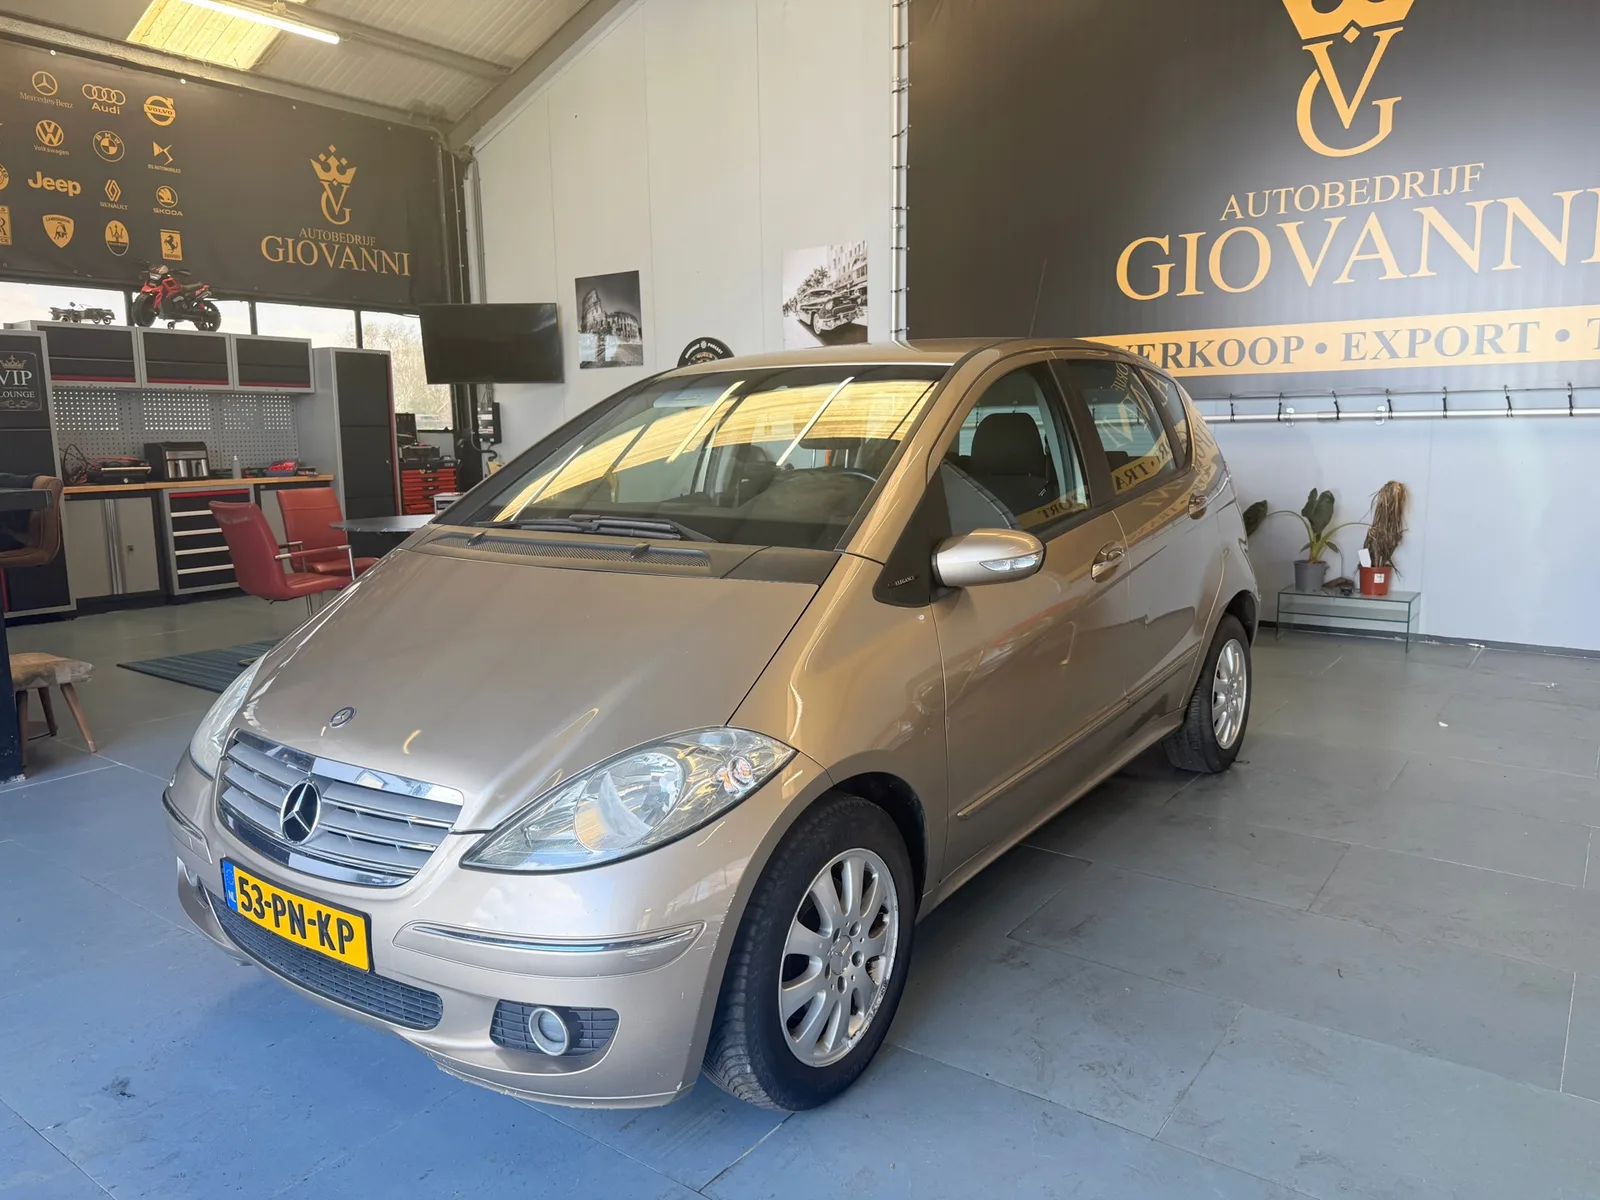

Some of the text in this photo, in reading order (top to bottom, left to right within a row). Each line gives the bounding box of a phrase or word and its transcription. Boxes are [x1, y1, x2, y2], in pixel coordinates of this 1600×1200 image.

[91, 102, 120, 115] Audi
[147, 106, 174, 116] VOLVO
[33, 145, 70, 156] Volkswagen
[27, 171, 82, 197] Jeep
[1220, 163, 1485, 221] AUTOBEDRIJF
[99, 201, 128, 210] RENAULT
[299, 227, 376, 247] AUTOBEDRIJF
[260, 235, 411, 276] GIOVANNI
[1340, 321, 1541, 361] EXPORT
[0, 369, 32, 385] VIP
[238, 876, 355, 955] 53-PN-KP
